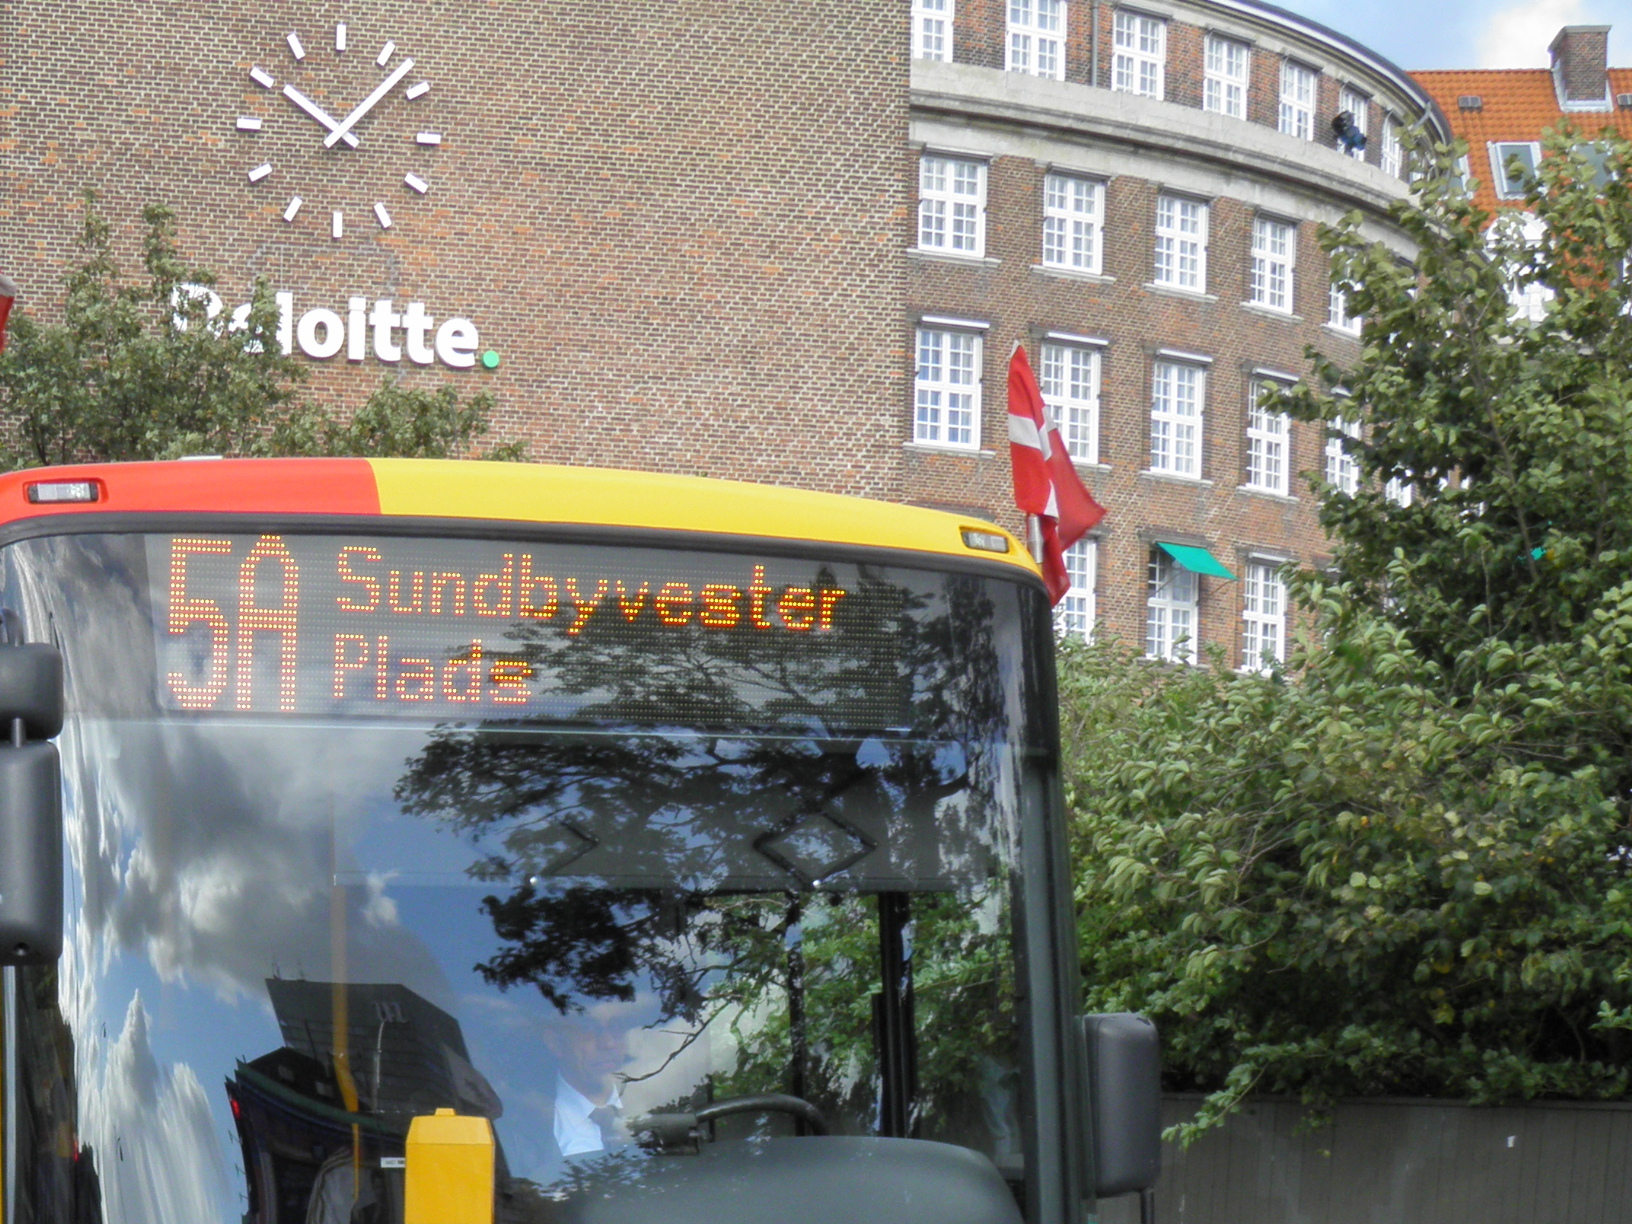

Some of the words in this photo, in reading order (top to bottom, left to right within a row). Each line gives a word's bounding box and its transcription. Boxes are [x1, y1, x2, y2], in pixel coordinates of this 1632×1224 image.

[168, 534, 299, 711] 5A
[337, 545, 847, 635] Sundbyvester
[333, 633, 533, 703] Plads
